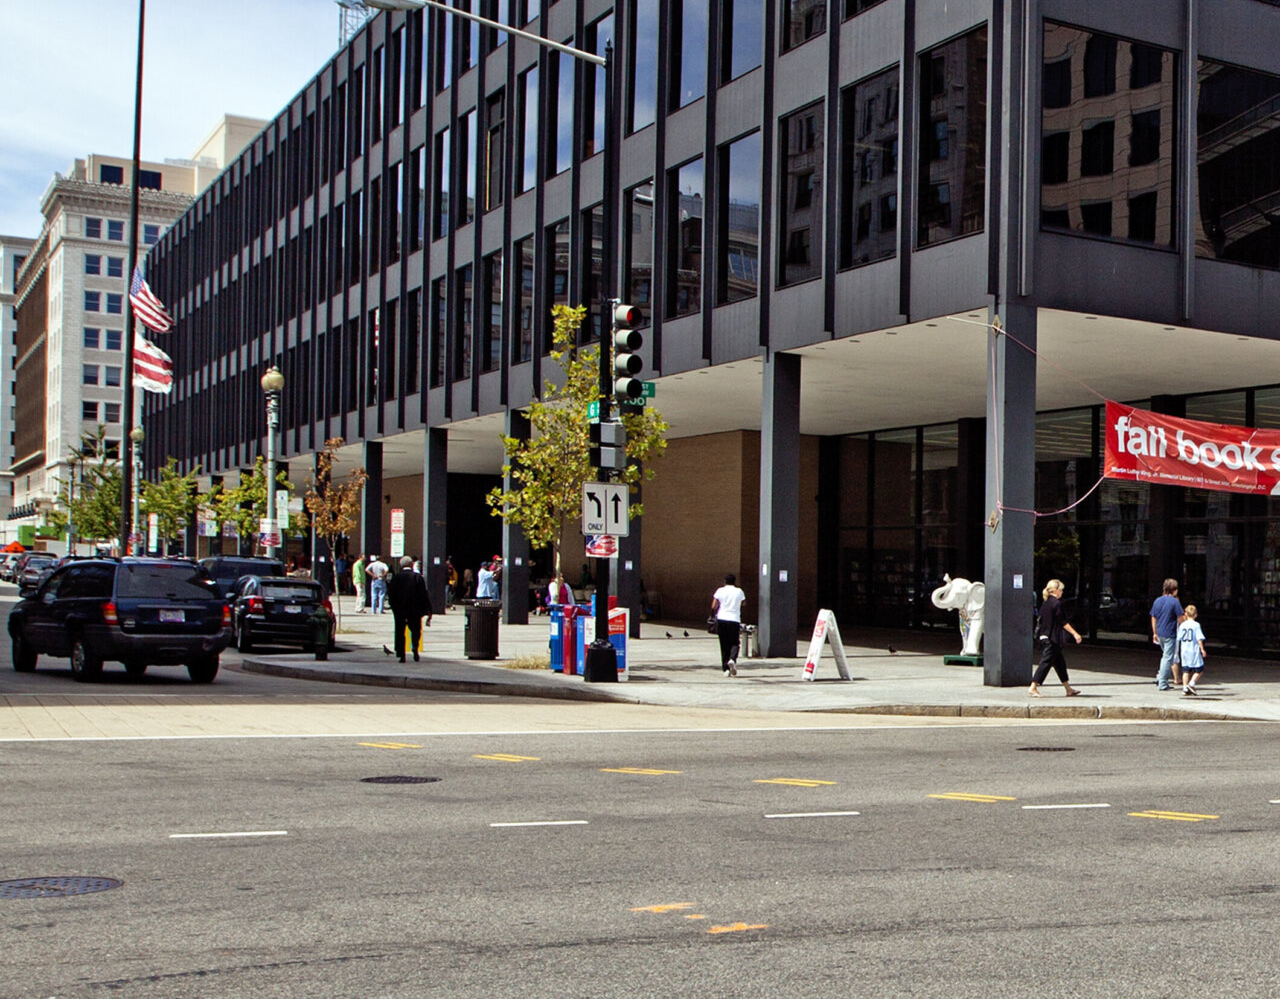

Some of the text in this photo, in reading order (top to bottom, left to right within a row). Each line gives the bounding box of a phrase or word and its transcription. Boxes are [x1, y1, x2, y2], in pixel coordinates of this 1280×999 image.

[1114, 415, 1168, 459] fall
[1176, 429, 1266, 471] book
[1182, 628, 1193, 642] 20
